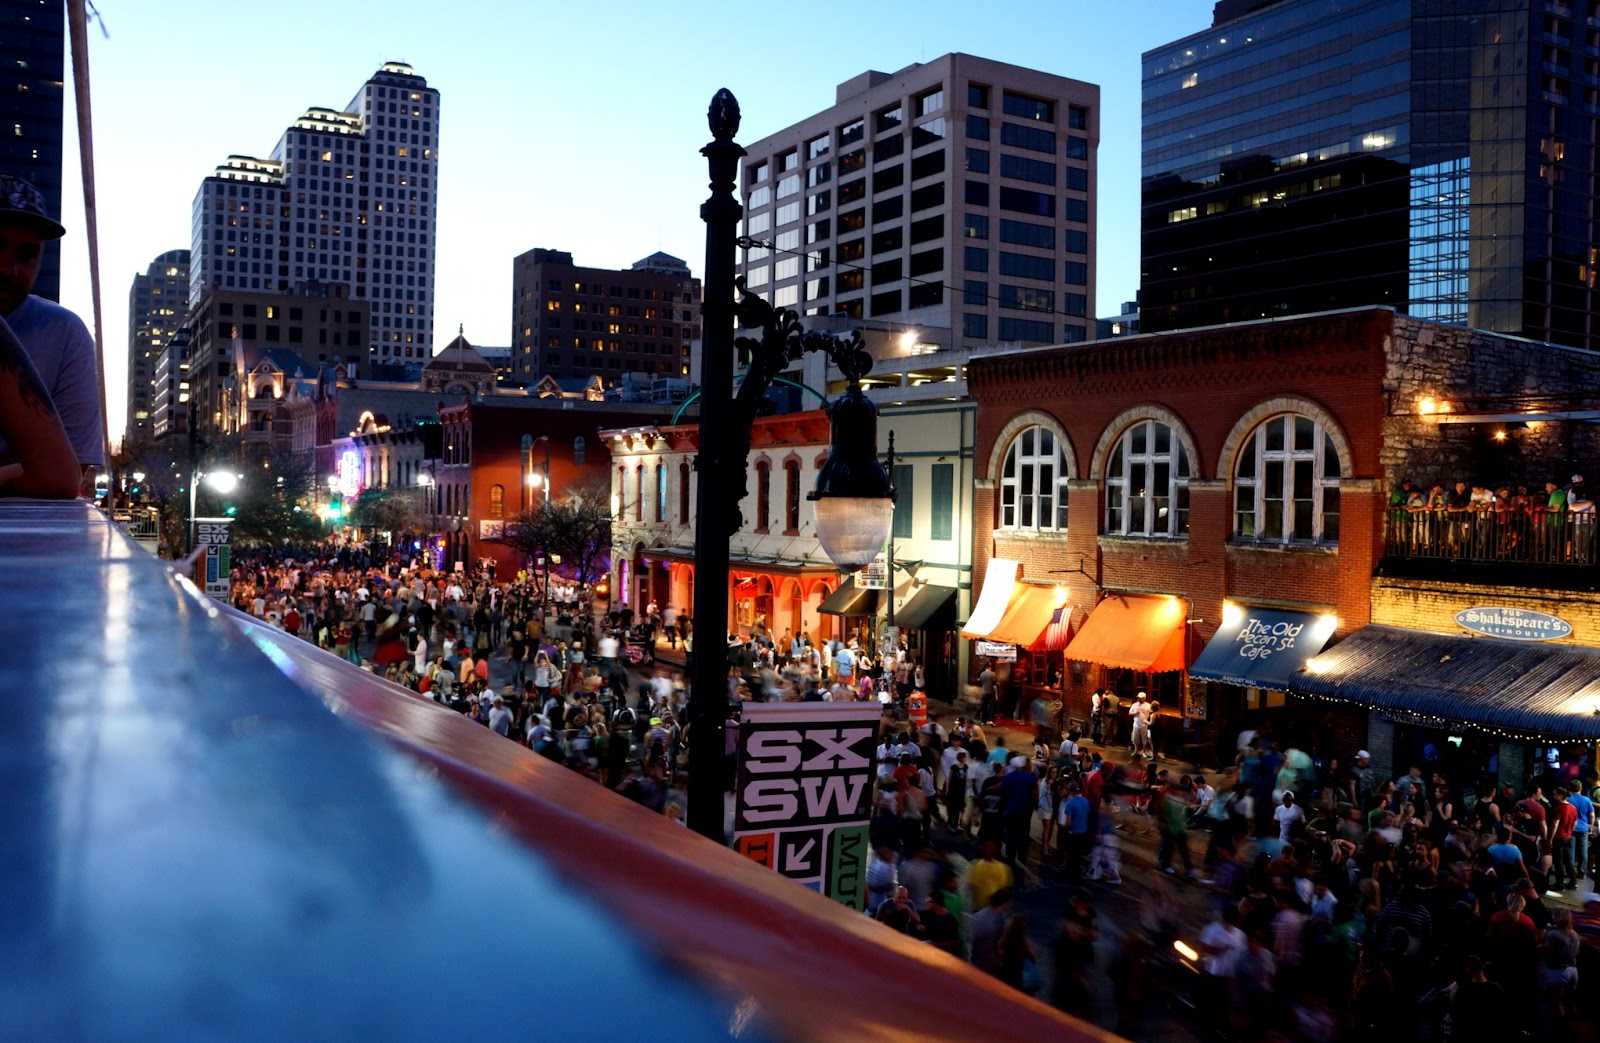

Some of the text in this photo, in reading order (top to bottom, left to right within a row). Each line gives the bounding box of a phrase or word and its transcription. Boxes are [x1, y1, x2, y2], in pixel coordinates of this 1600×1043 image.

[198, 524, 229, 534] SX
[198, 534, 229, 544] SW
[1466, 610, 1561, 631] Shakespeare's
[1503, 609, 1520, 617] PUB
[1247, 618, 1304, 637] The Old
[1506, 626, 1546, 638] HOUSE
[1236, 629, 1295, 651] Pecan St.
[1240, 644, 1272, 660] Cafe
[745, 728, 873, 774] SX
[742, 774, 869, 823] SW
